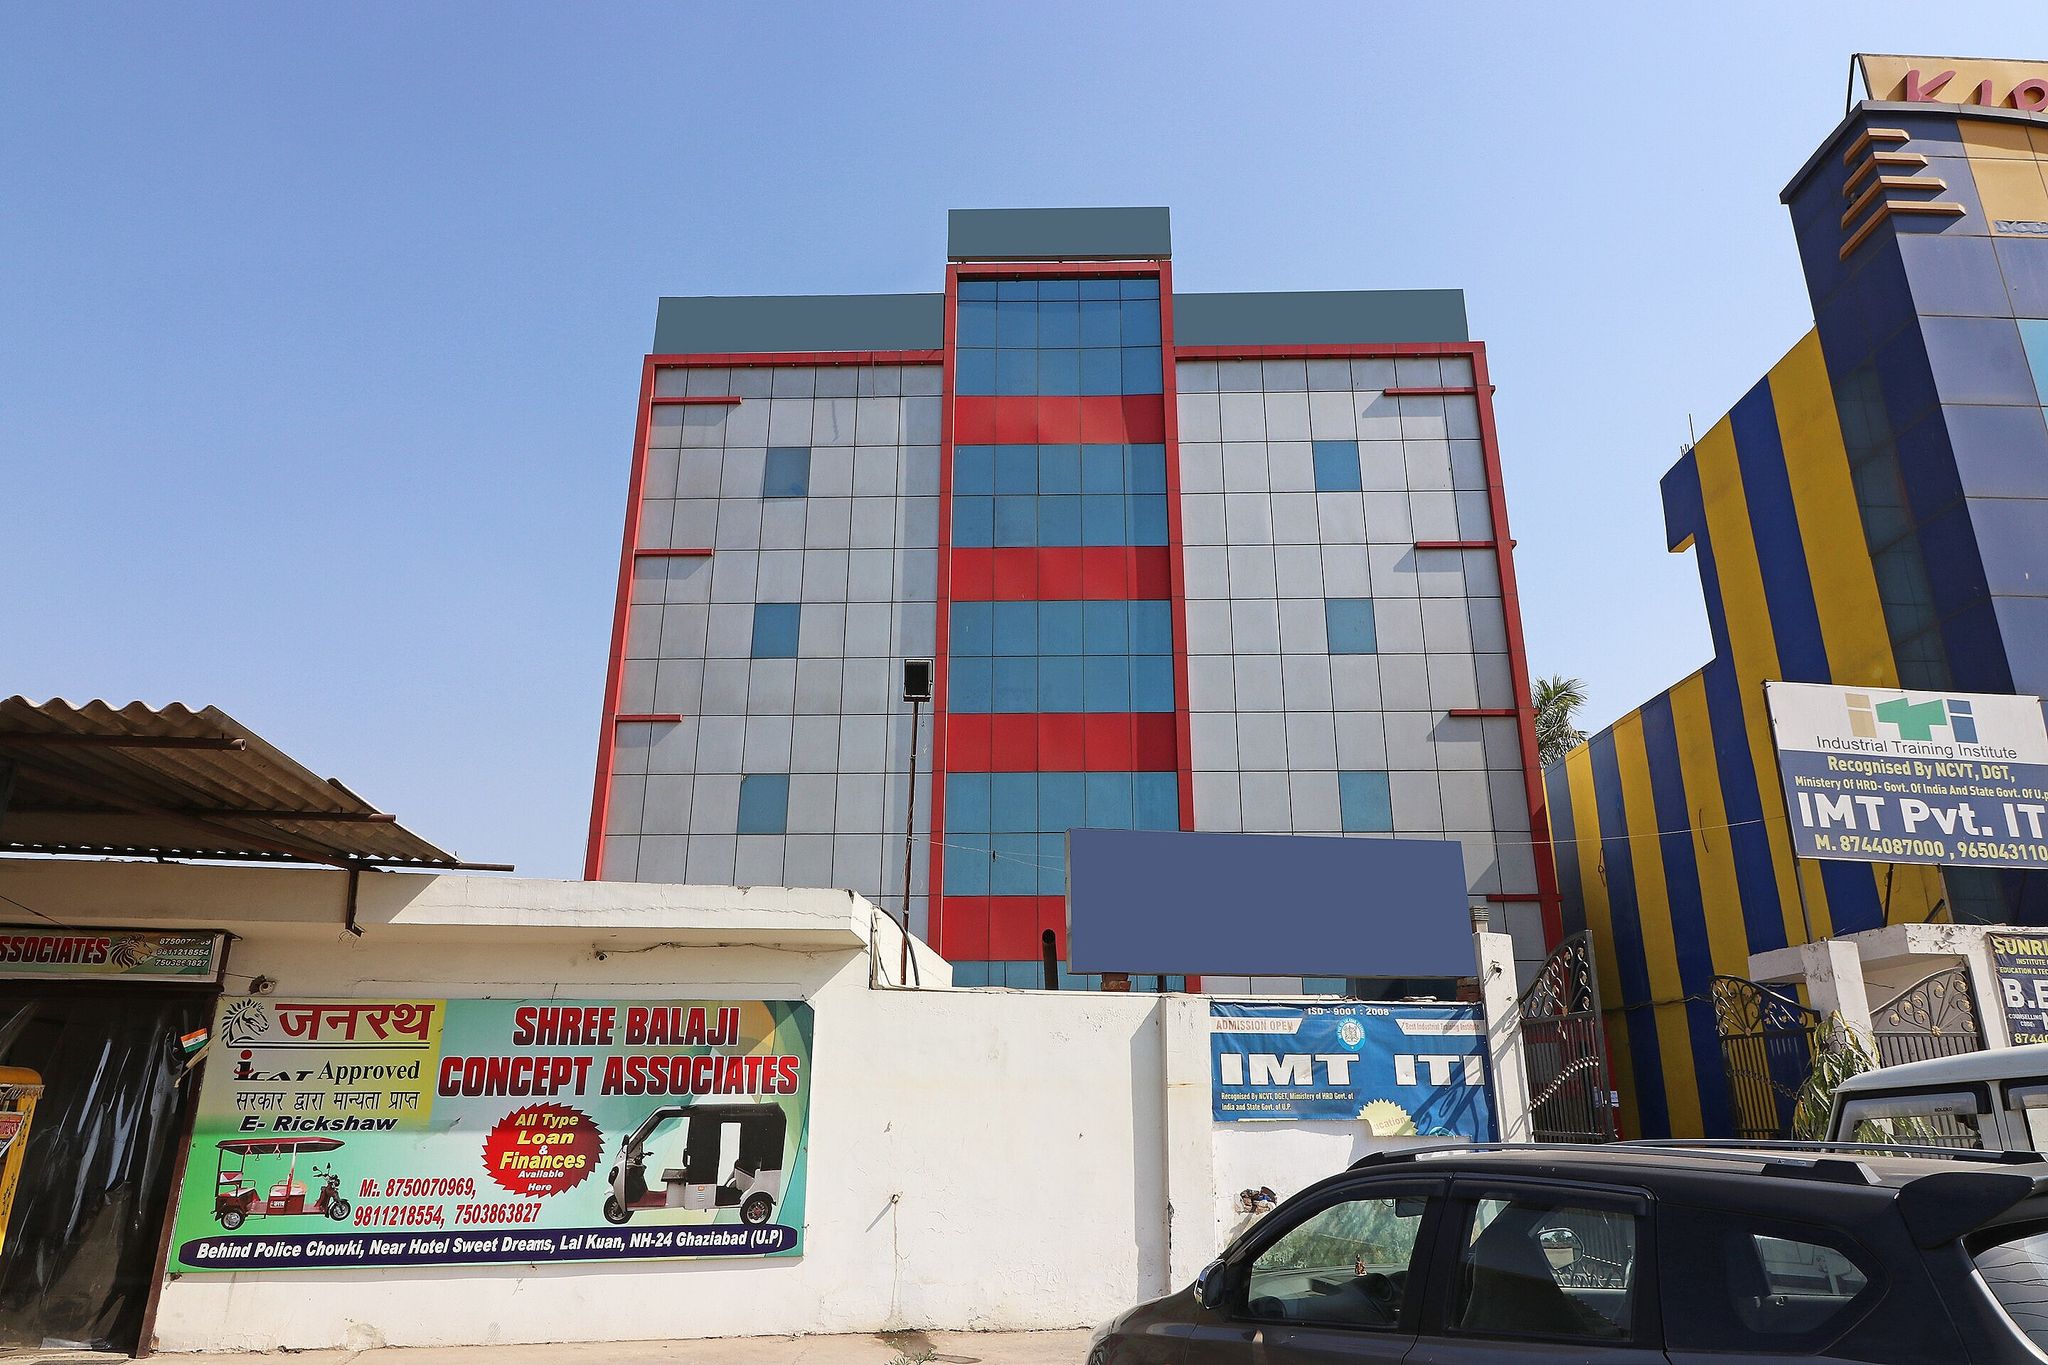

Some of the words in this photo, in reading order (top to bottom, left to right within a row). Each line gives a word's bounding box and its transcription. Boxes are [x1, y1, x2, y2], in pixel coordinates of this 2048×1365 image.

[1816, 735, 1888, 752] Industrial
[1891, 741, 1954, 758] Training
[1958, 744, 2017, 759] Institute
[1827, 755, 1911, 776] Recognised
[1914, 761, 1932, 780] By
[1935, 762, 1980, 781] NCVT,
[1980, 764, 2016, 783] DGT,
[1795, 775, 1841, 791] Ministery
[1843, 779, 1854, 789] Of
[1856, 780, 1882, 791] HRD-
[1884, 781, 1909, 793] Govt.
[1911, 783, 1921, 794] Of
[1923, 784, 1948, 795] India
[1950, 785, 1968, 796] And
[1969, 786, 1995, 798] State
[1996, 787, 2021, 799] Govt.
[2022, 789, 2033, 799] Of
[1797, 792, 1885, 831] IMT
[1899, 798, 1994, 837] Pvt.
[1815, 834, 1837, 851] M.
[1840, 835, 1945, 857] 8744087000
[2000, 966, 2032, 974] EDUCATION
[2016, 958, 2046, 966] INSTITUTE
[1308, 1007, 1324, 1015] ISO
[1366, 1008, 1390, 1016] 2008
[275, 1003, 436, 1041] जनरथ
[513, 1007, 616, 1046] SHREE
[624, 1007, 740, 1046] BALAJI
[1216, 1020, 1267, 1031] ADMISSION
[1270, 1021, 1294, 1031] OPEN
[317, 1060, 420, 1085] Approved
[438, 1057, 593, 1097] CONCEPT
[601, 1055, 801, 1096] ASSOCIATES
[1220, 1053, 1359, 1086] IMT
[1394, 1054, 1486, 1086] ITI
[236, 1092, 288, 1111] सरकार
[294, 1092, 326, 1111] द्वारा
[333, 1091, 383, 1110] मान्यता
[388, 1091, 421, 1110] प्राप्त
[1221, 1092, 1250, 1101] Recognised
[1251, 1093, 1258, 1101] By
[1221, 1103, 1235, 1111] India
[1235, 1103, 1246, 1111] and
[239, 1115, 266, 1131] E-
[272, 1115, 399, 1131] Rickshaw
[515, 1114, 538, 1126] All
[543, 1113, 579, 1128] Type
[517, 1131, 575, 1145] Loan
[499, 1151, 586, 1169] Finances
[539, 1145, 548, 1155] &
[517, 1170, 565, 1178] Available
[385, 1177, 477, 1200] 8750070969,
[527, 1183, 553, 1191] Here
[353, 1204, 446, 1229] 9811218554,
[454, 1202, 542, 1224] 7503863827
[196, 1242, 252, 1258] Behind
[254, 1241, 301, 1258] Police
[305, 1239, 365, 1258] Chowki,
[368, 1240, 406, 1256] Near
[408, 1238, 450, 1255] Hotel
[452, 1236, 499, 1254] Sweet
[501, 1236, 555, 1254] Dreams,
[559, 1235, 583, 1251] Lal
[585, 1234, 626, 1251] Kuan,
[629, 1231, 673, 1248] NH-24
[676, 1230, 748, 1247] Ghaziabad
[750, 1228, 783, 1248] (U.P)
